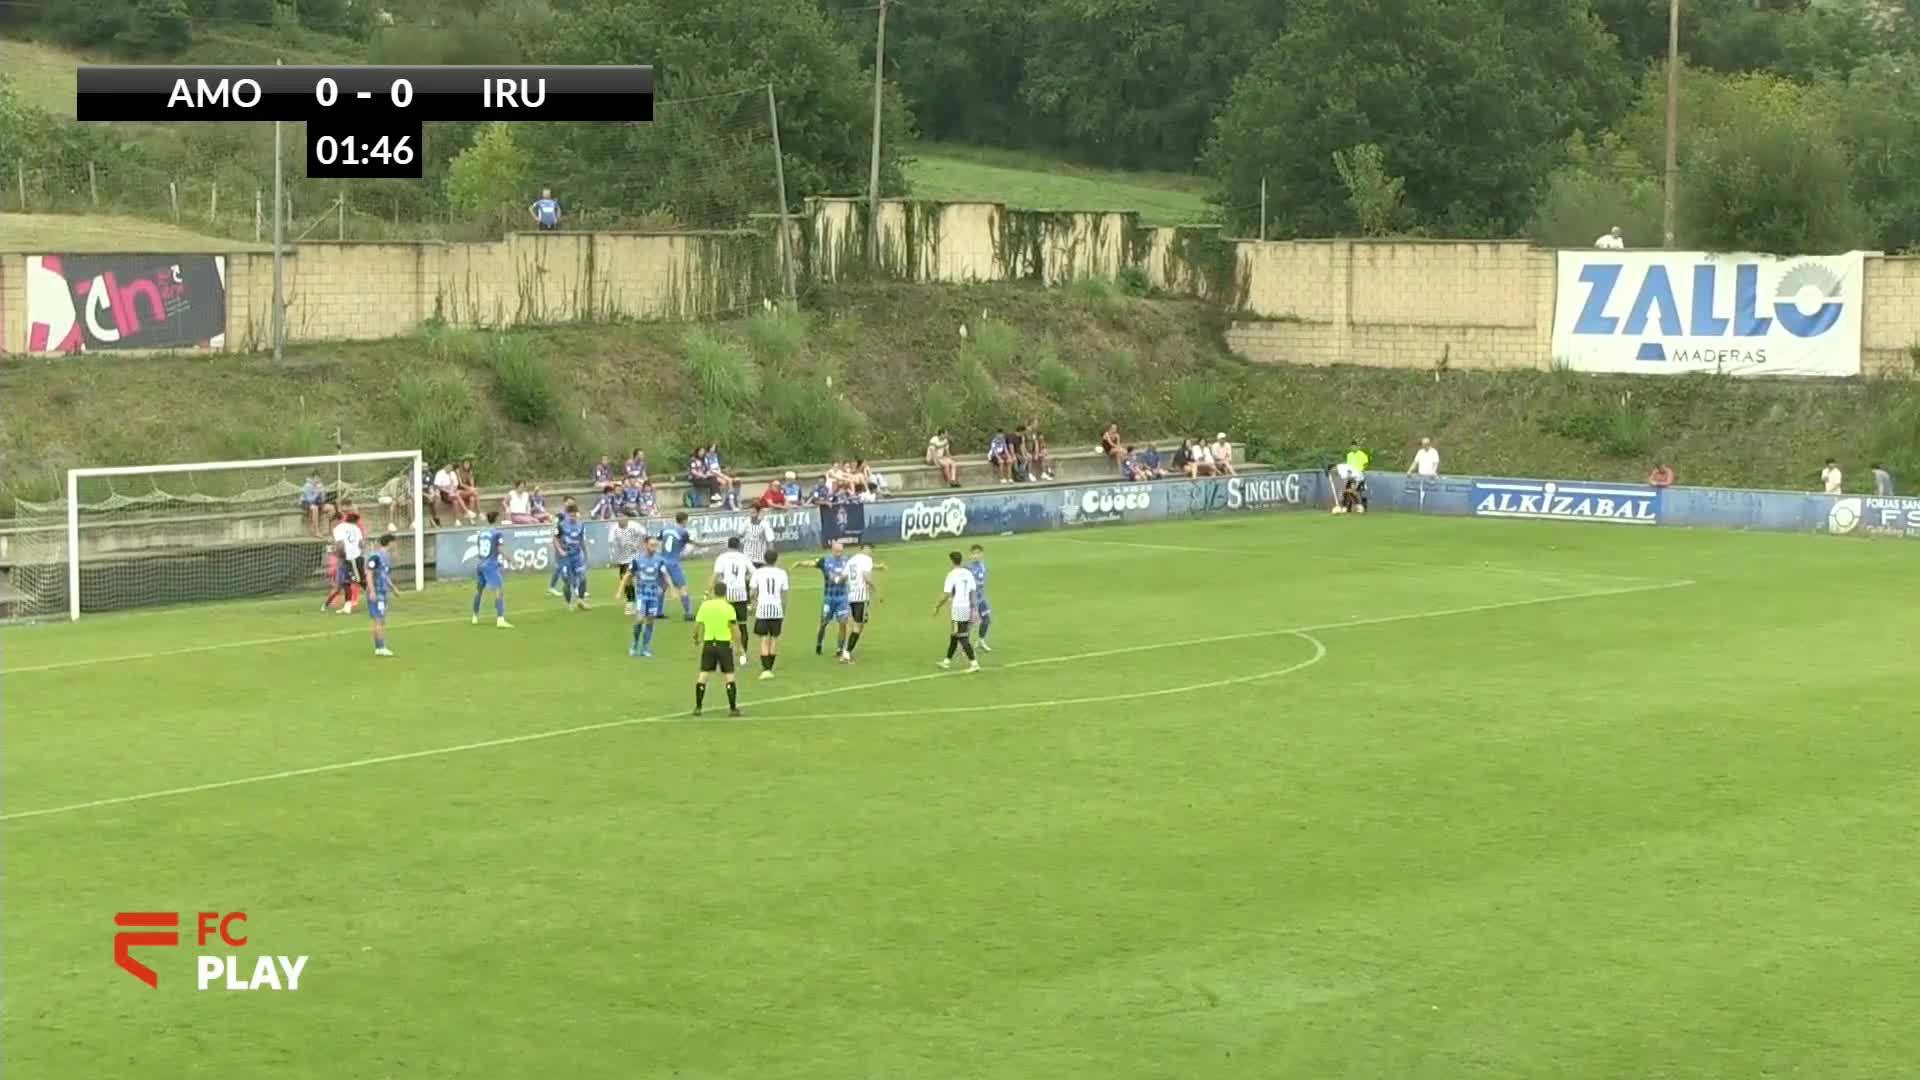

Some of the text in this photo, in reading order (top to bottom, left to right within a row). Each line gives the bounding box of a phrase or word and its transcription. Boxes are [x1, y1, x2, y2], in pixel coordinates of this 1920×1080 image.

[1573, 263, 1843, 360] ZALLO
[1673, 349, 1767, 364] MADERAS
[1227, 473, 1300, 509] SINGING
[766, 577, 776, 594] 11
